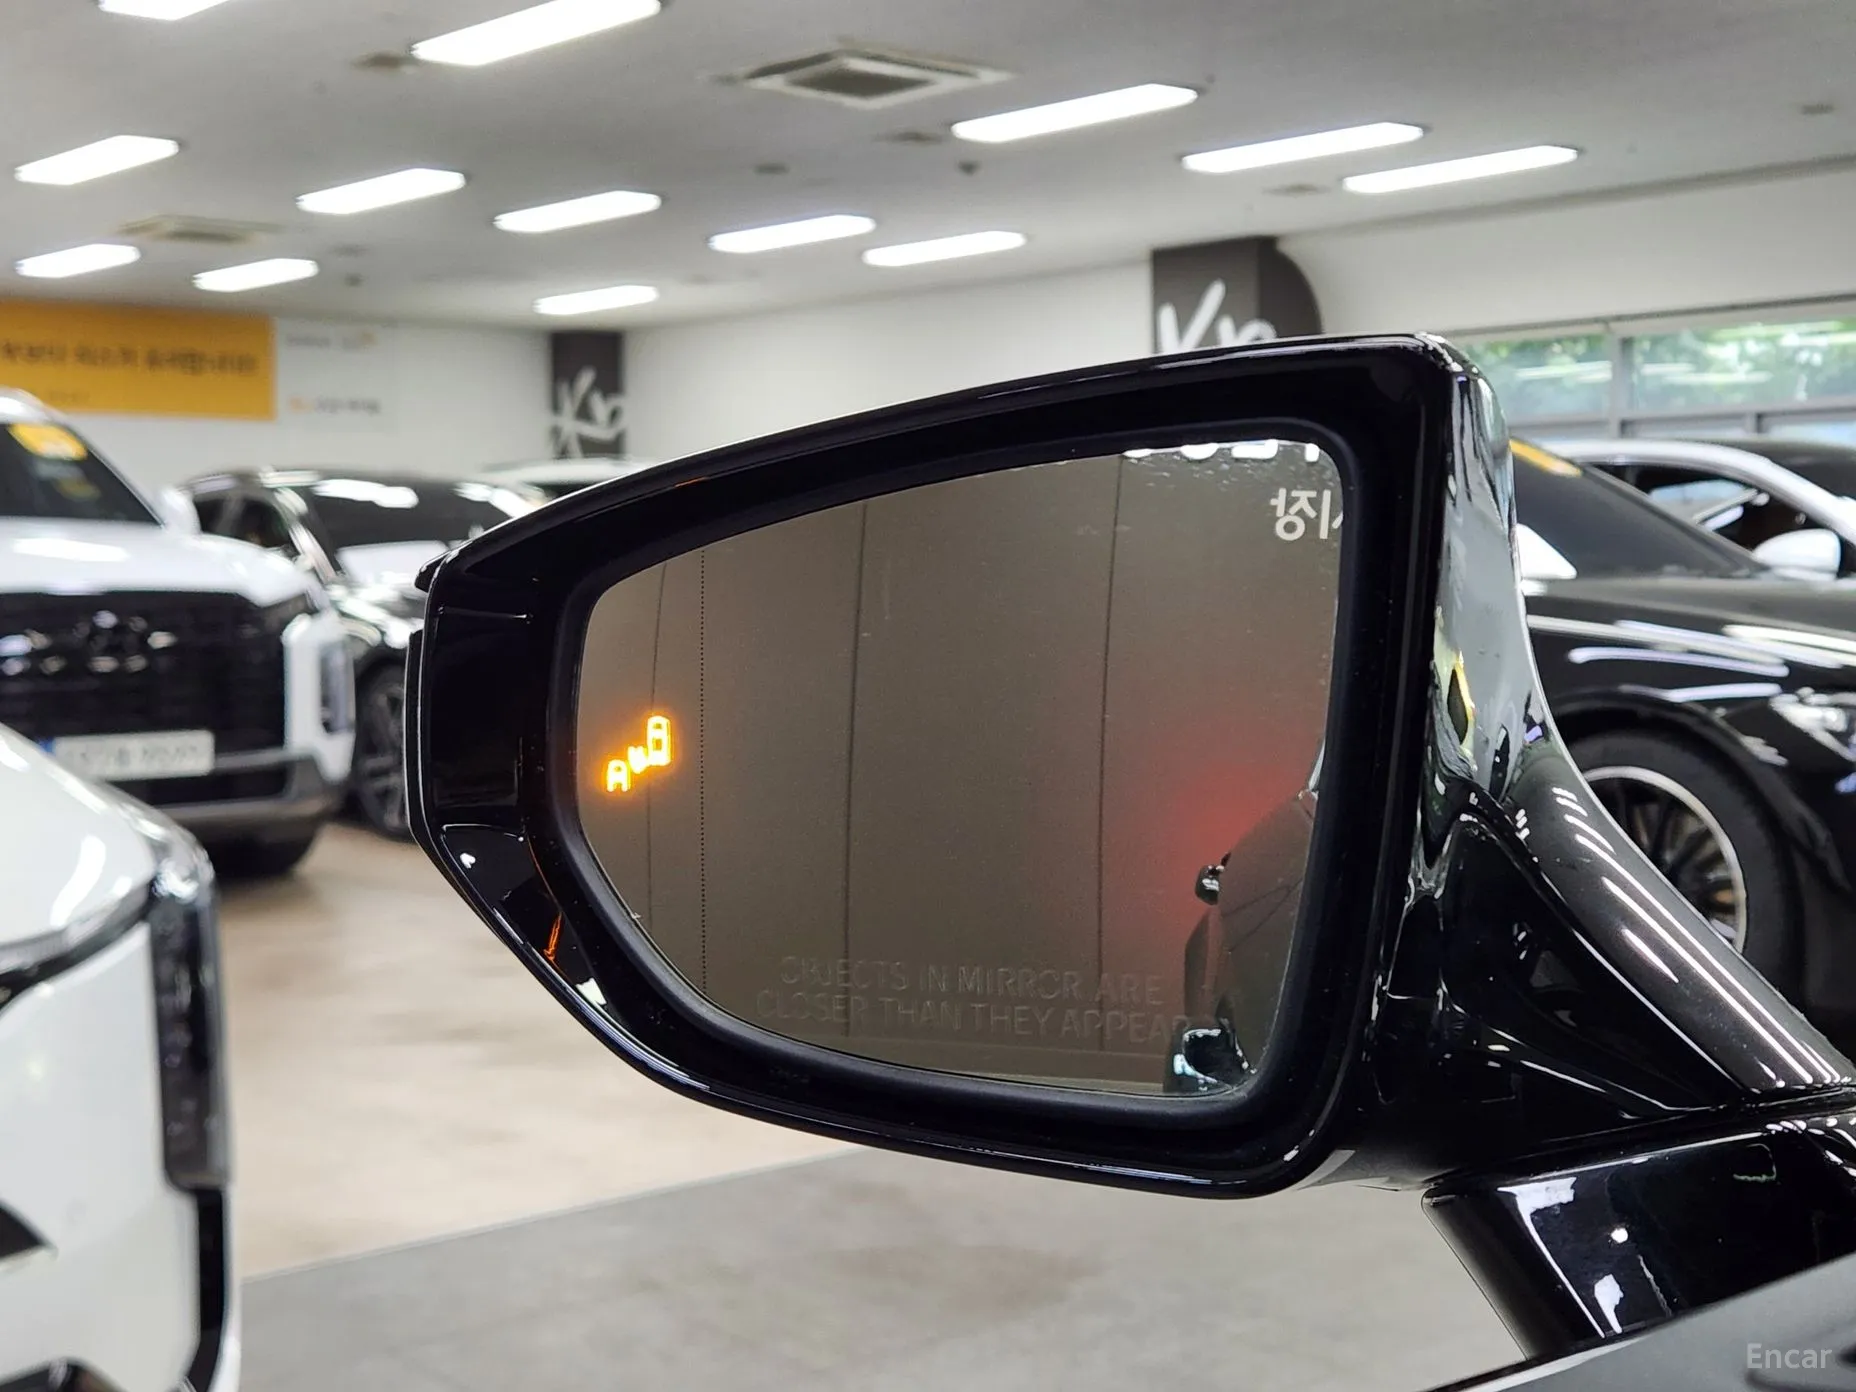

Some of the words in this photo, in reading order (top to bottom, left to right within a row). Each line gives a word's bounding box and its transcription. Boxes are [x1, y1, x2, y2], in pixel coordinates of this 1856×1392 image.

[780, 955, 910, 991] OBJECTS
[920, 963, 948, 994] IN
[957, 964, 1082, 1002] MIRROR
[1090, 971, 1165, 1006] ARE
[756, 987, 869, 1029] CLOSER
[877, 995, 963, 1033] THAN
[970, 1002, 1056, 1039] THEY
